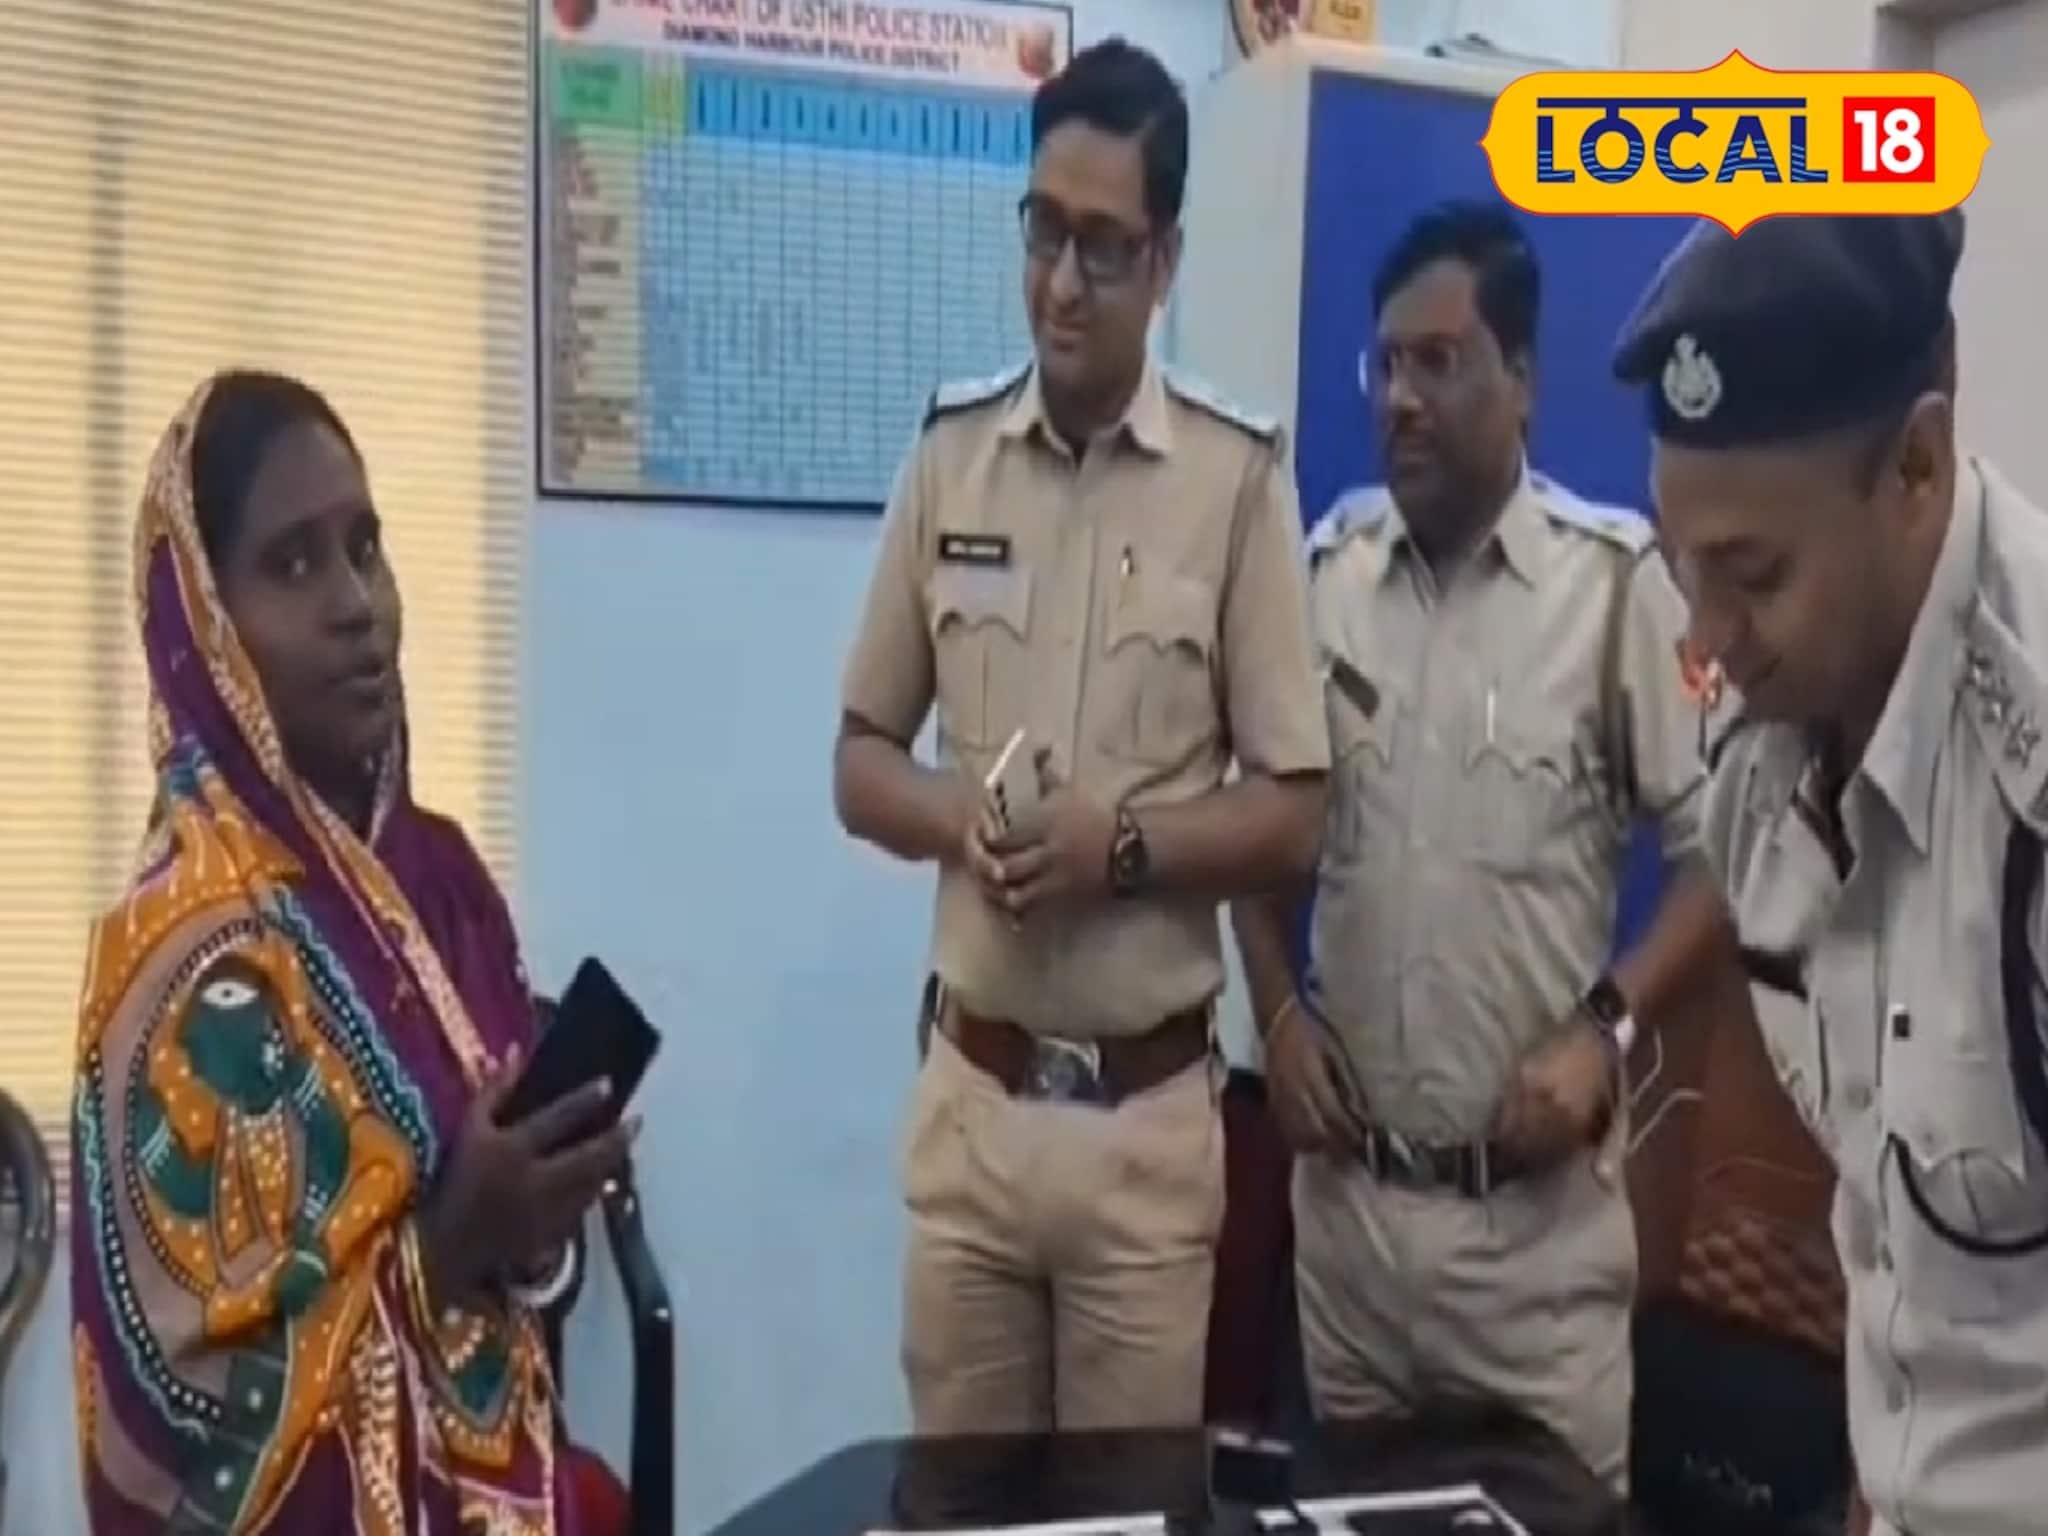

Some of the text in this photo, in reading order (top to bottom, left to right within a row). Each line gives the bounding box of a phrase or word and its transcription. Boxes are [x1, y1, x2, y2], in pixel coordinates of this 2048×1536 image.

[663, 19, 959, 72] DIAMOND HARBOUR POLICE DISTRICT
[853, 5, 926, 42] POLICE
[928, 12, 1007, 50] STATION
